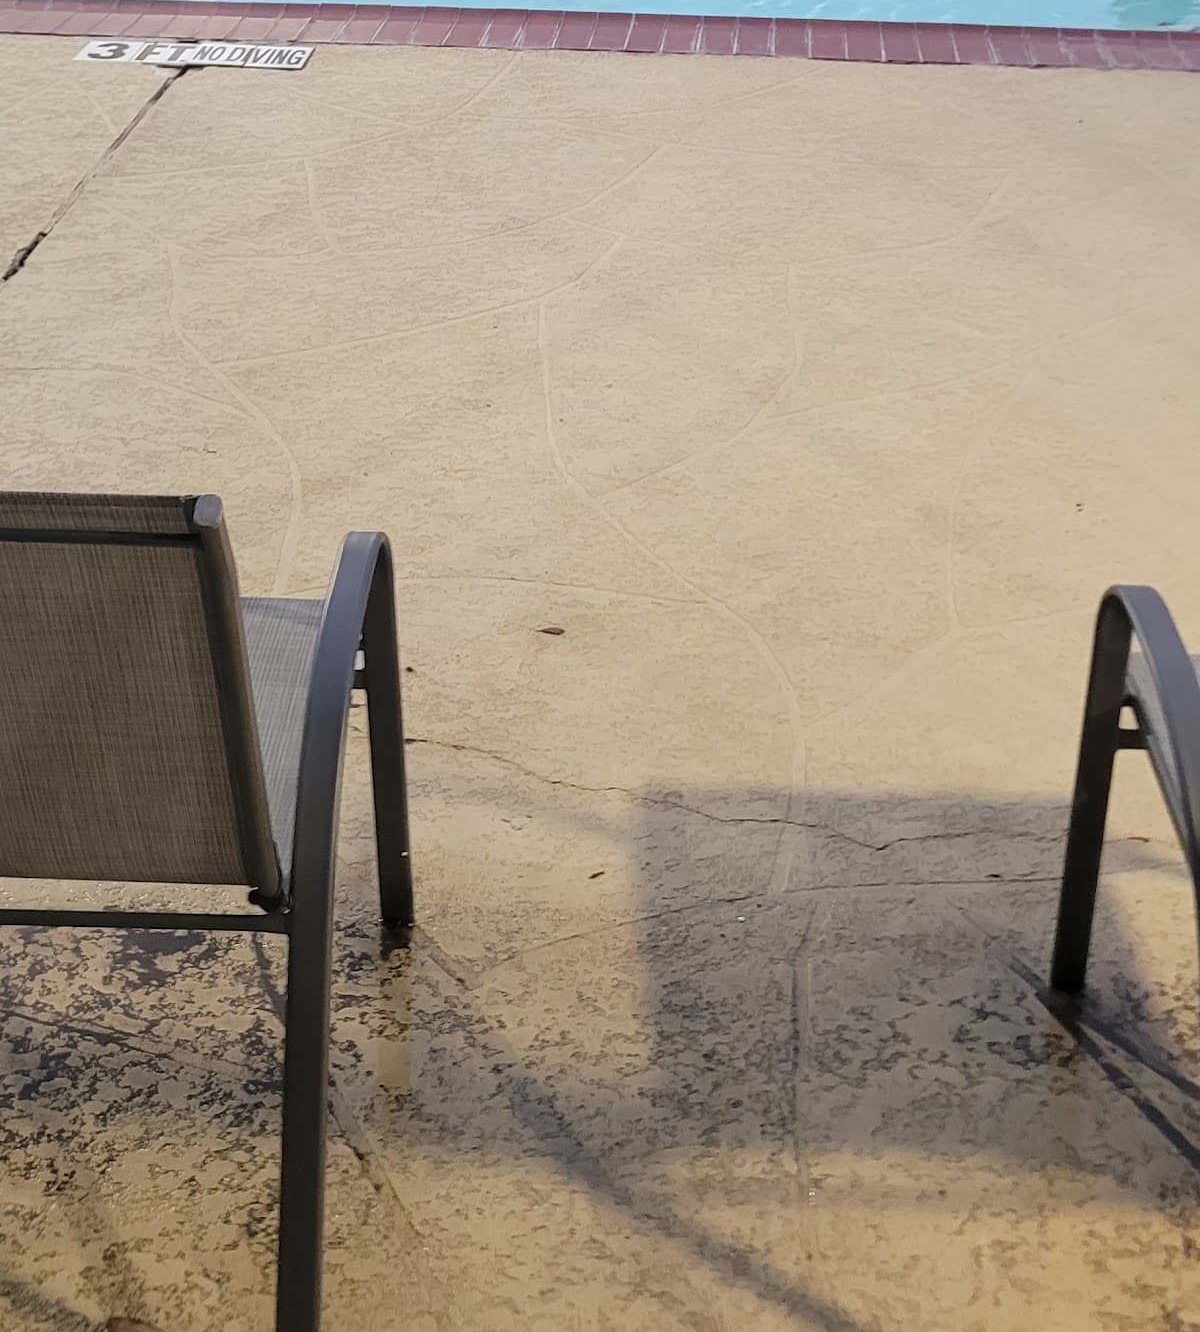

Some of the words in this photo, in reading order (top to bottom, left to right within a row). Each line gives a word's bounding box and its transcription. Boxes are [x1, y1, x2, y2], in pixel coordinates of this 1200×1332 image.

[87, 43, 130, 59] 3
[135, 44, 196, 61] FT
[192, 45, 225, 61] NO
[227, 46, 306, 65] DIVING
